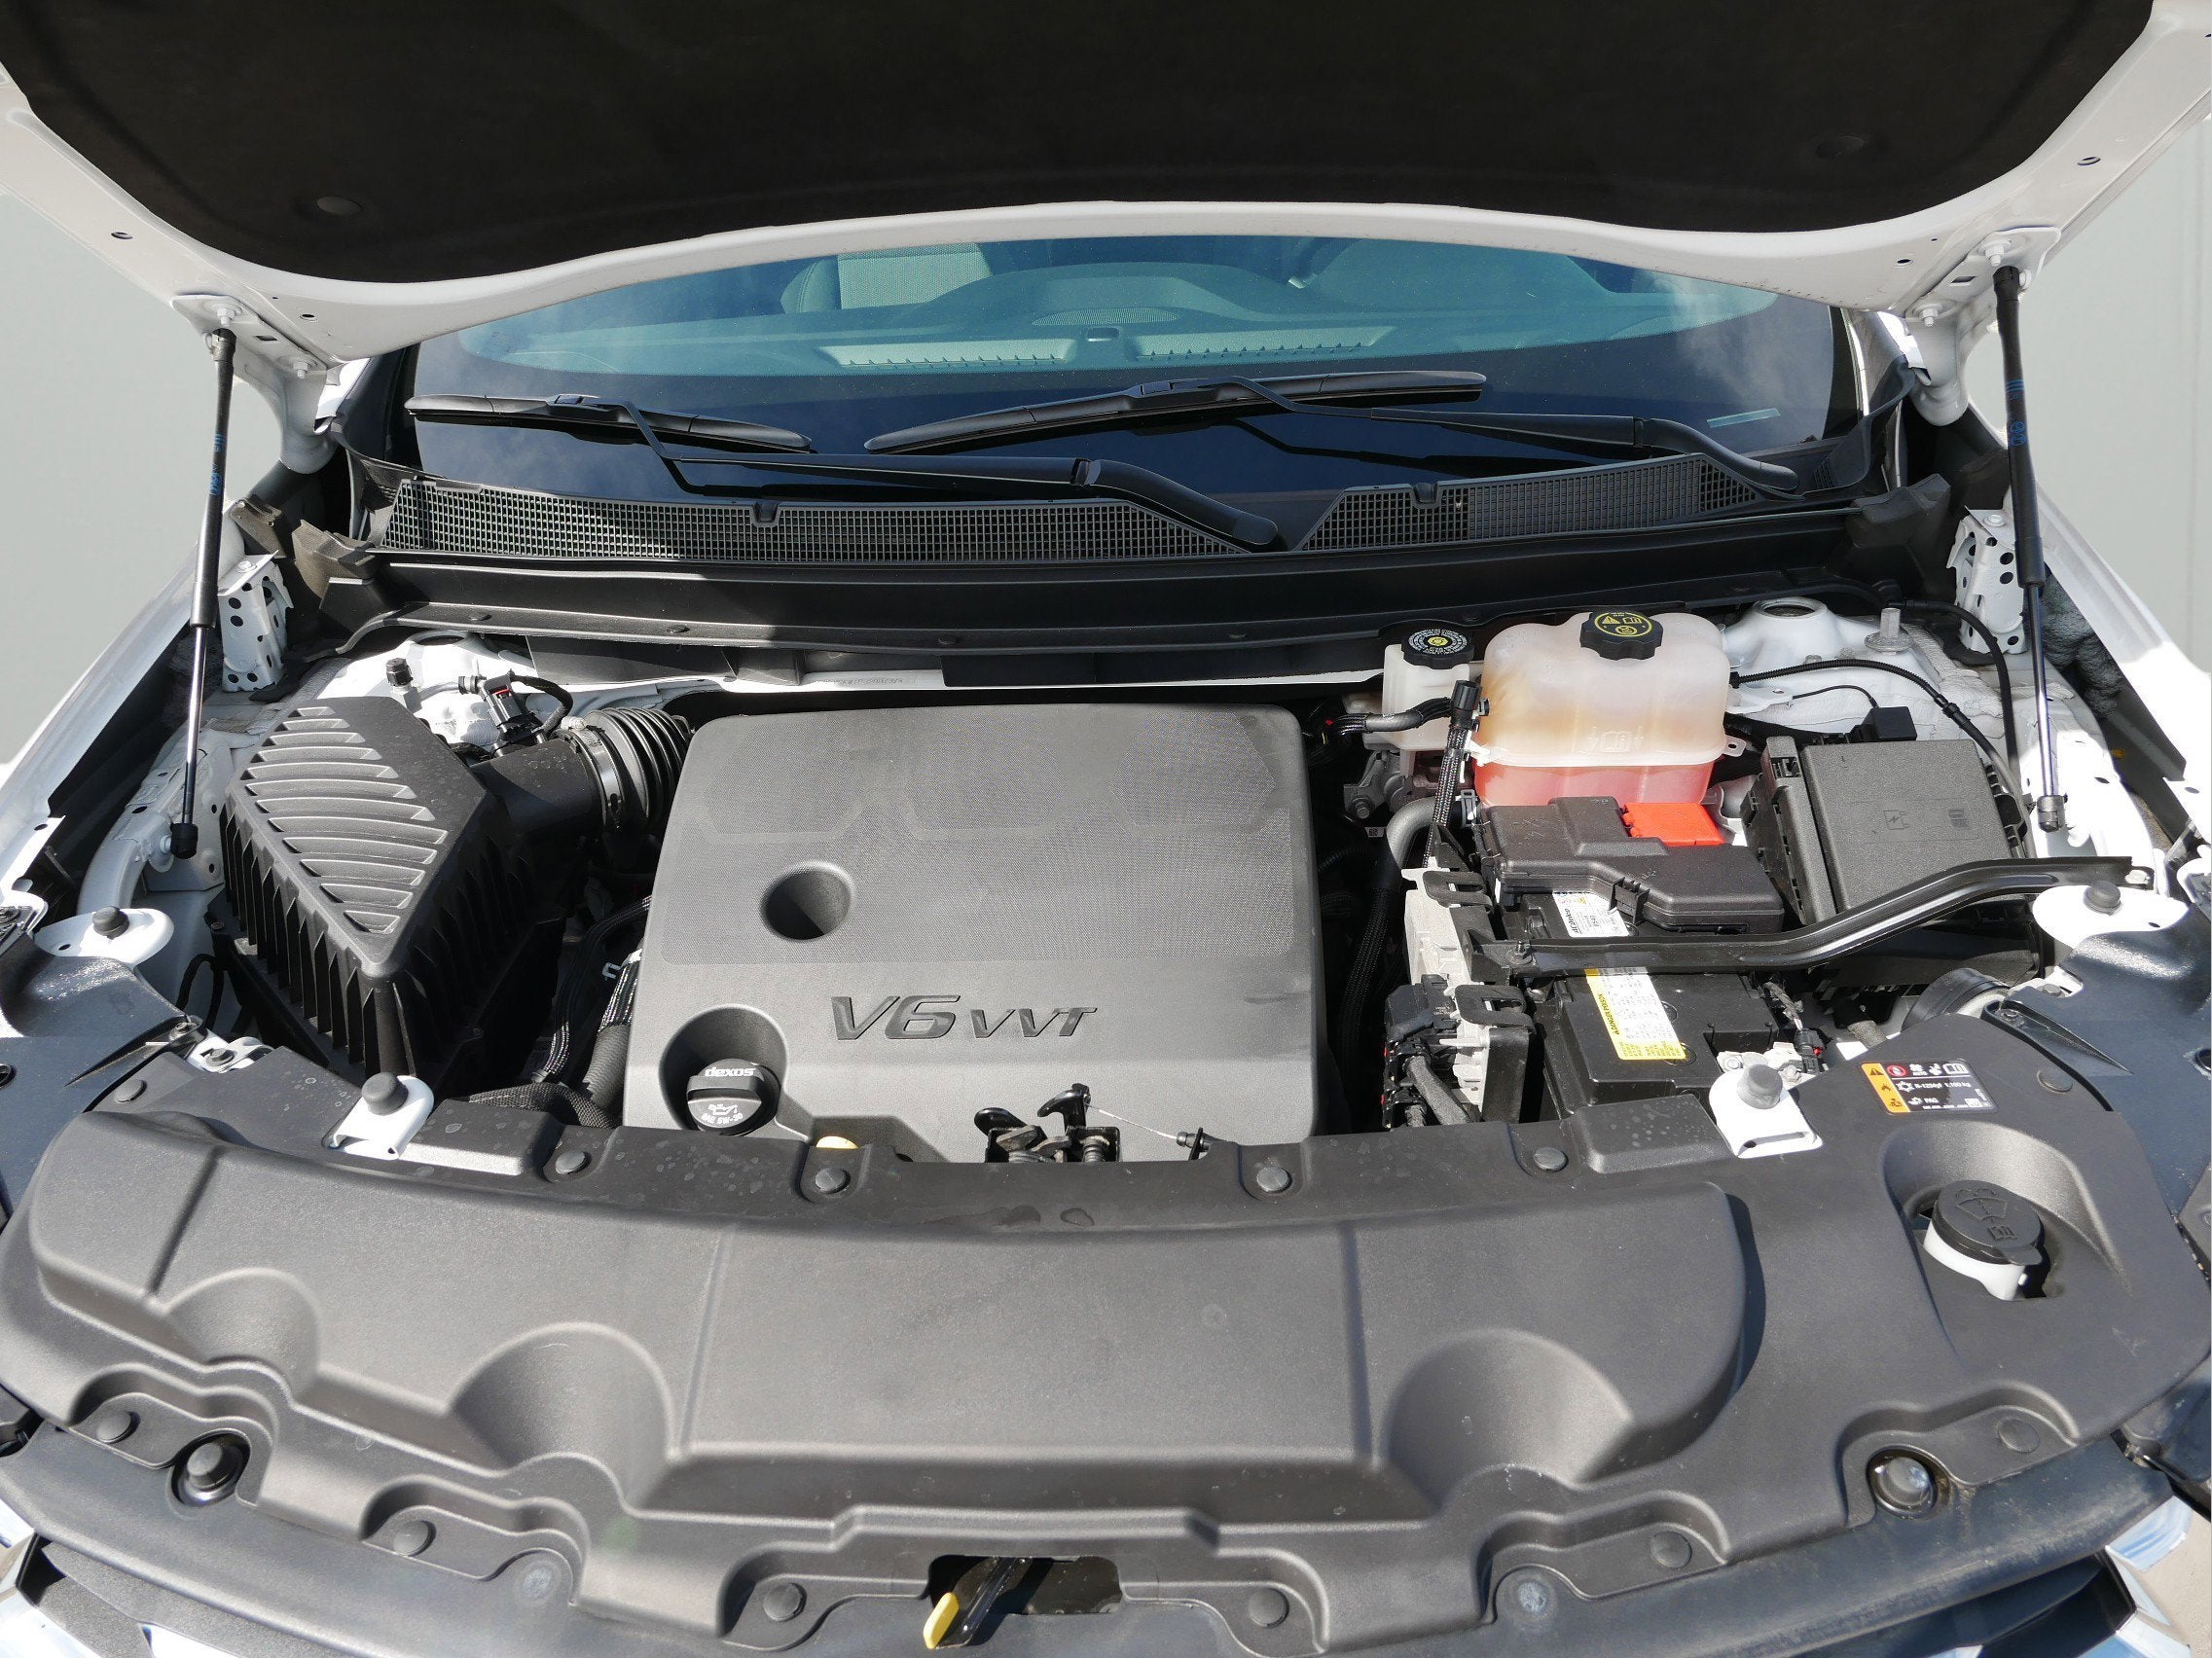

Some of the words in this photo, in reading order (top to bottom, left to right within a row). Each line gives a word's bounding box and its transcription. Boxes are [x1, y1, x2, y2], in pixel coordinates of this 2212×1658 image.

[831, 994, 961, 1040] V6
[970, 1007, 1098, 1038] VVT
[705, 1066, 756, 1077] dexos
